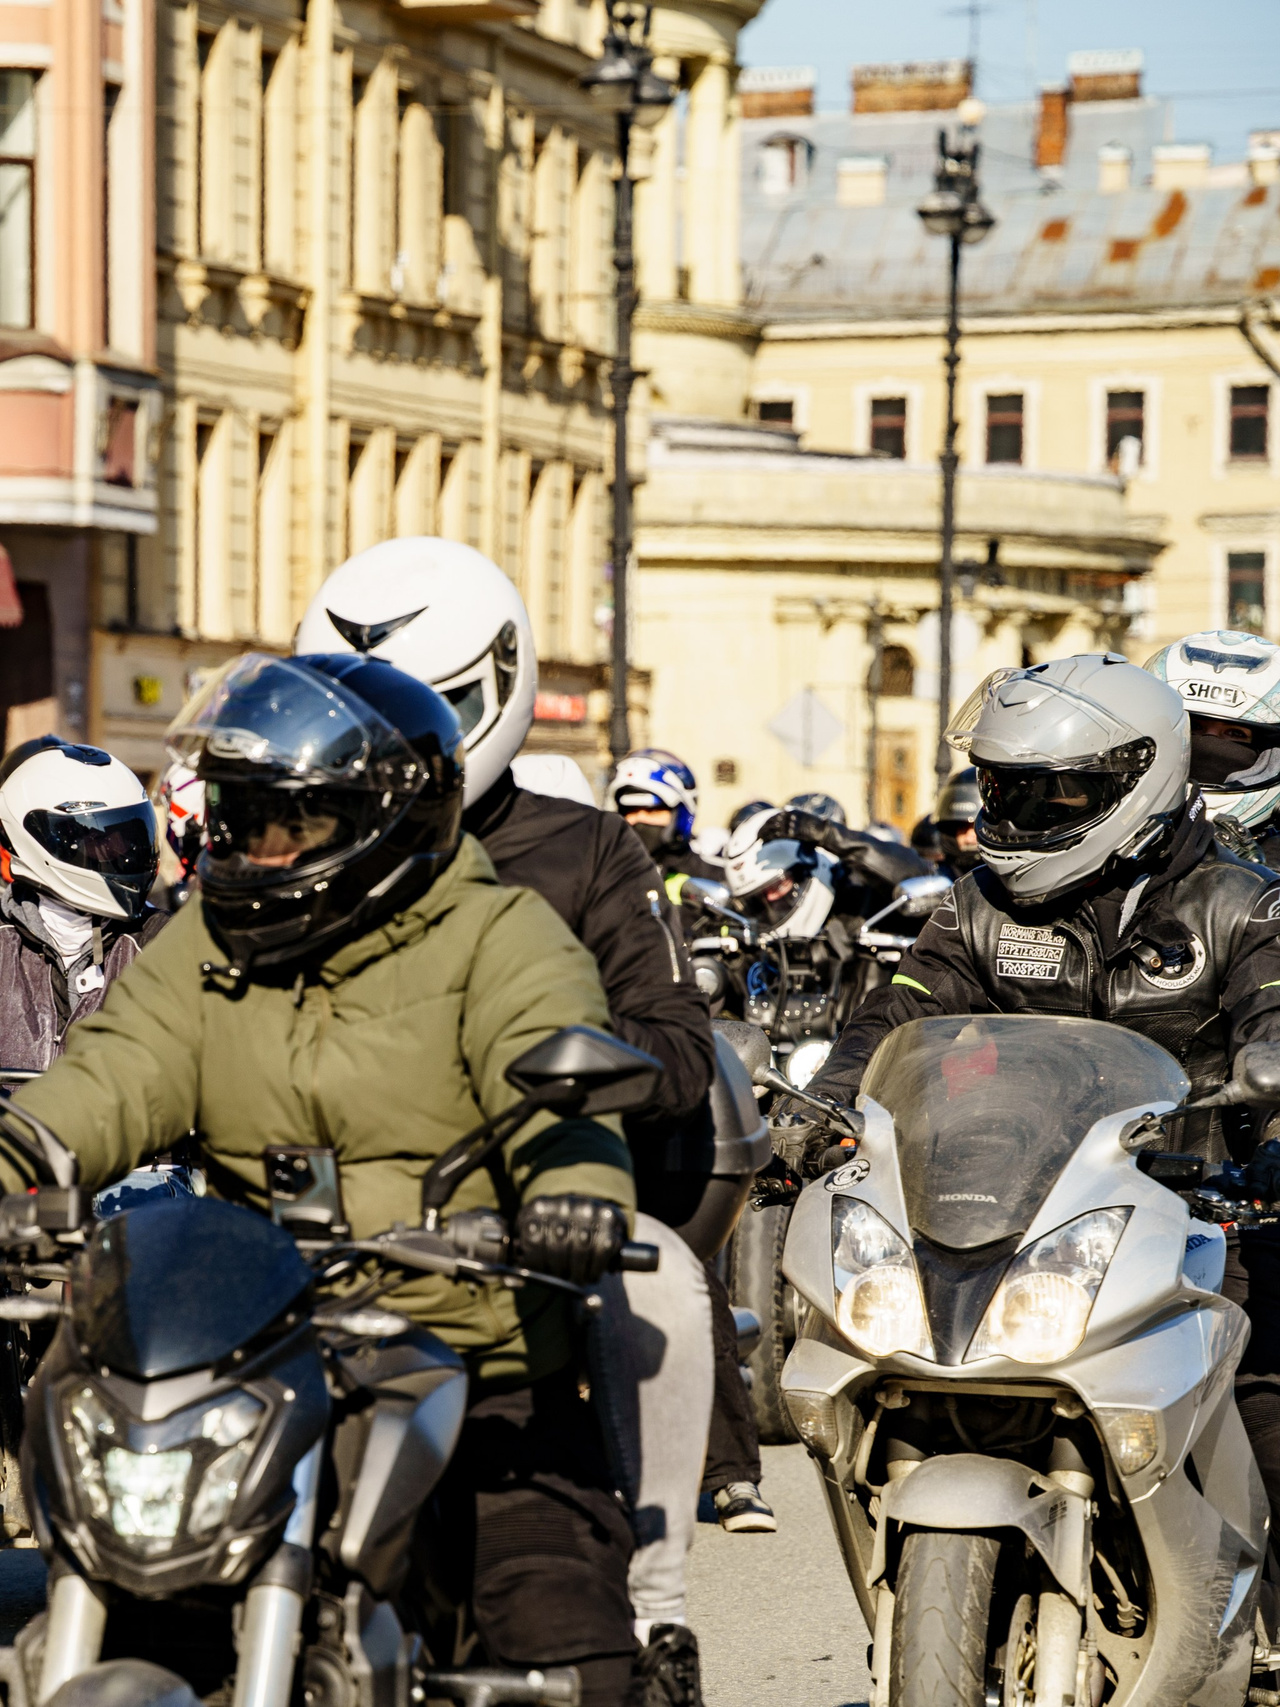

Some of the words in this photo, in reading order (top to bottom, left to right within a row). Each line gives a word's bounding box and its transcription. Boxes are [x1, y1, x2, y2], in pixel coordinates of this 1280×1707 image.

[1187, 683, 1238, 704] SHOEI
[1002, 962, 1052, 978] PROSPECT
[938, 1193, 998, 1204] HONDA
[1186, 1233, 1212, 1253] NDA
